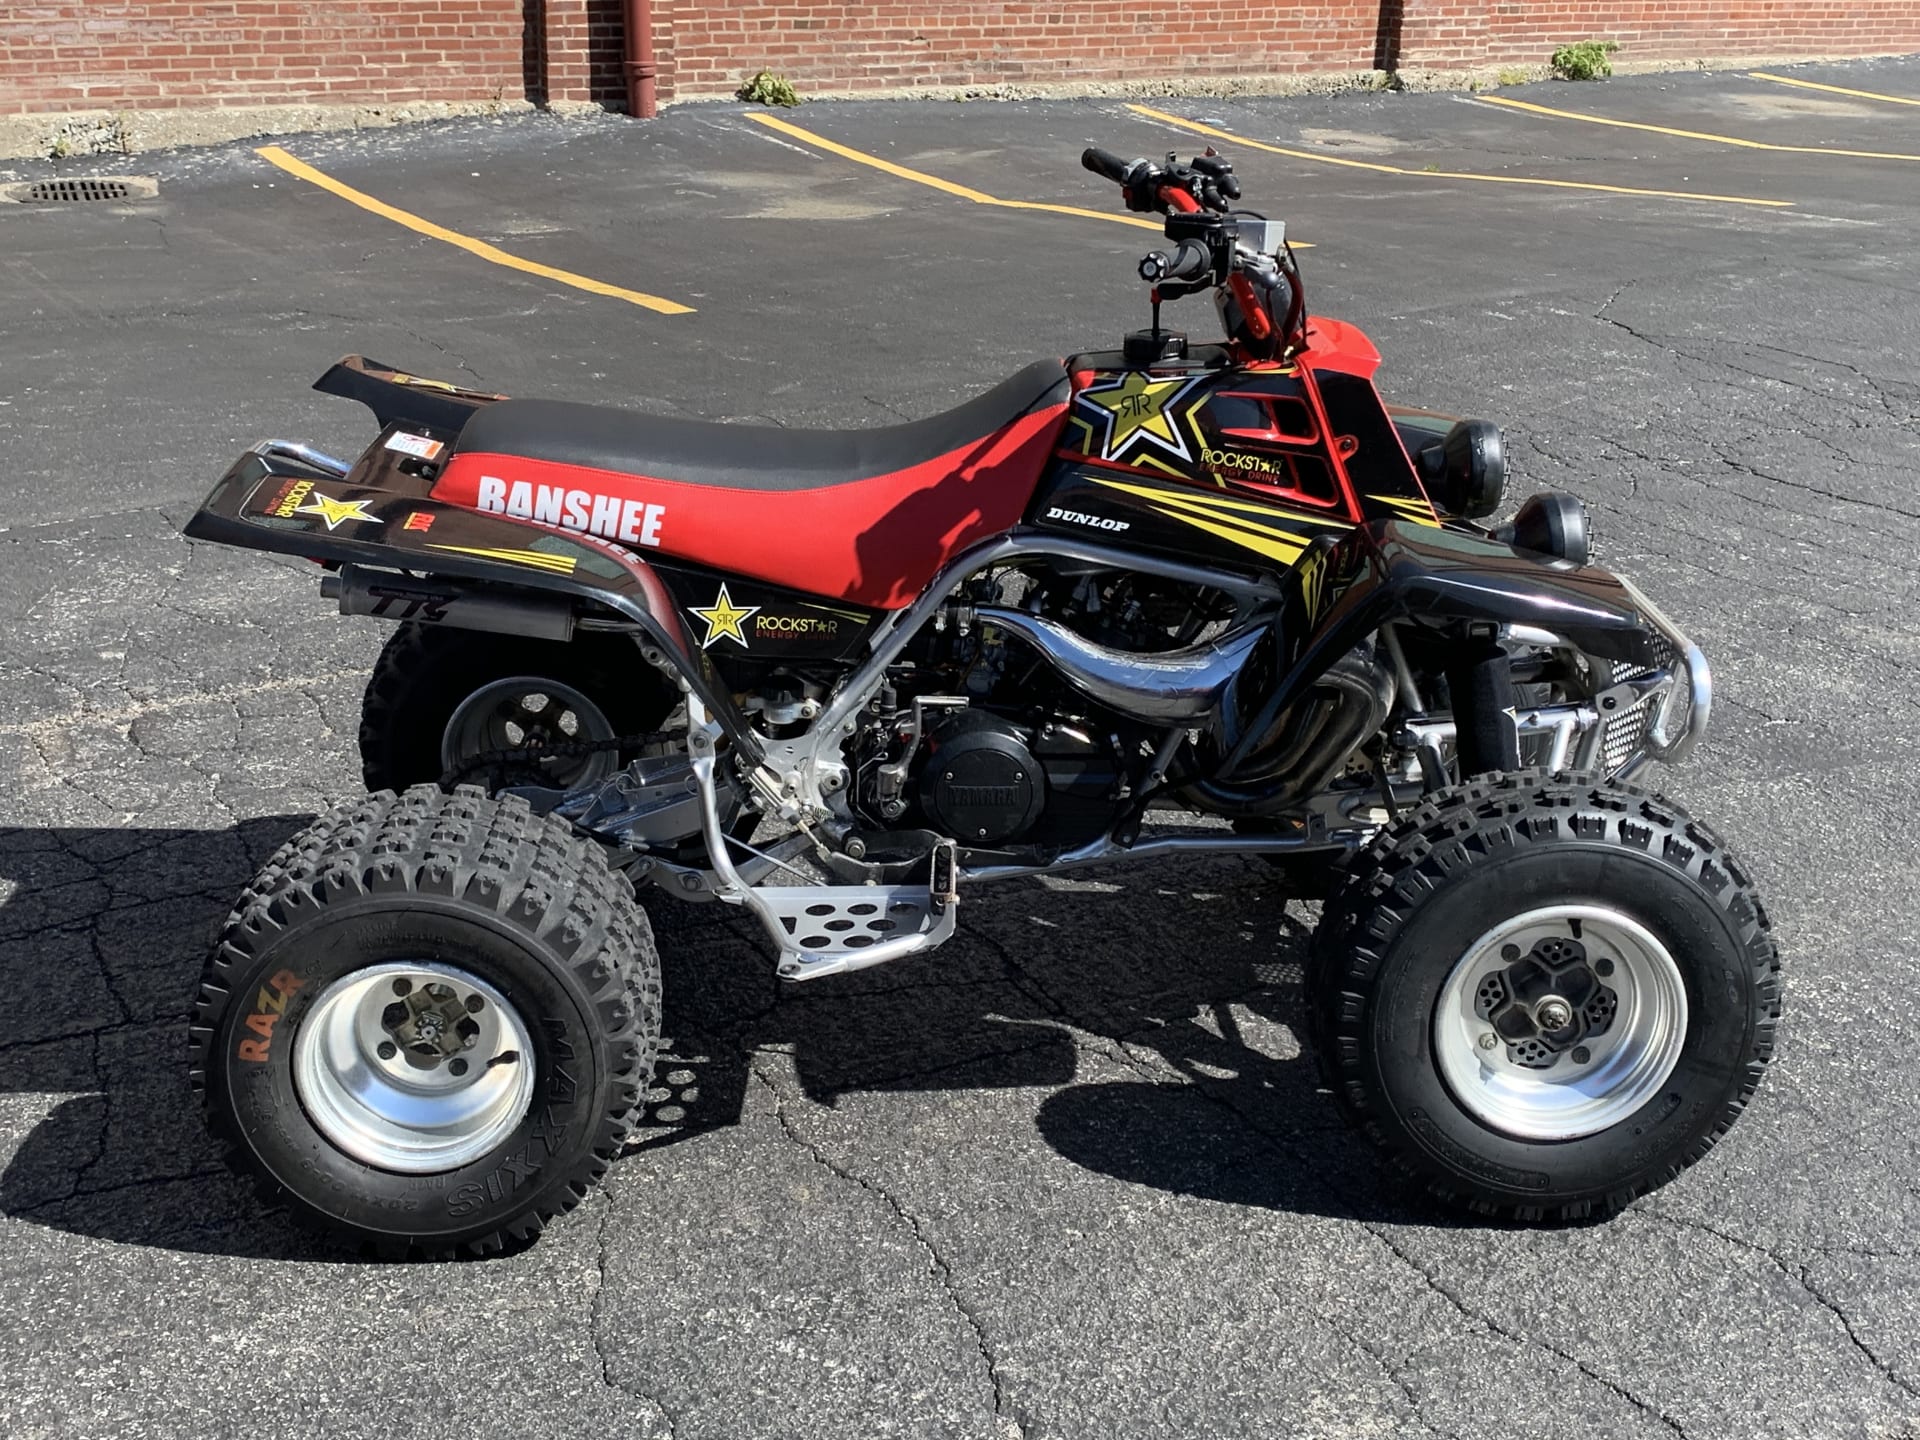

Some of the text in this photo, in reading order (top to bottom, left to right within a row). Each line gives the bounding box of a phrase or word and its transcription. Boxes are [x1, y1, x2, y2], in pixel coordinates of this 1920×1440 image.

[477, 475, 666, 547] BANSHEE
[1046, 507, 1130, 532] DUNLOP
[755, 629, 799, 640] ENERGY
[238, 968, 306, 1062] RAZR
[447, 1017, 577, 1217] MAXXIS
